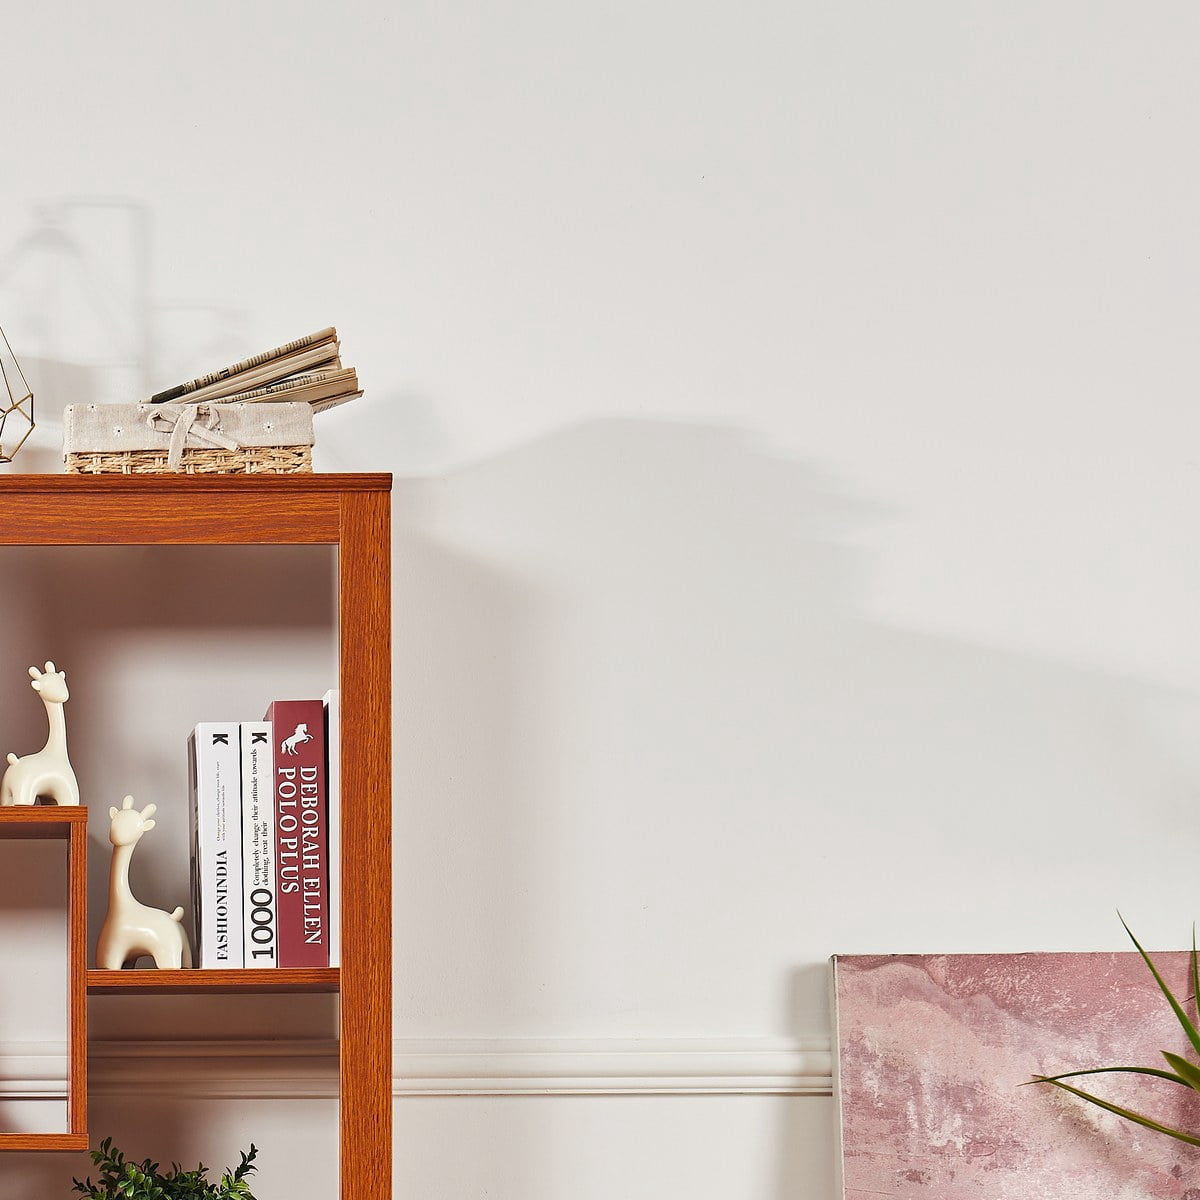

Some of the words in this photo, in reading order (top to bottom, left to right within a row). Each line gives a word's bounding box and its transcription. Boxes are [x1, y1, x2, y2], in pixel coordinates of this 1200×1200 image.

[212, 733, 229, 746] K
[250, 749, 258, 775] towards
[251, 732, 268, 745] K
[278, 767, 298, 832] POLO
[300, 766, 320, 870] DEBORAH
[253, 823, 261, 847] change
[253, 849, 261, 886] Completely
[280, 837, 299, 893] PLUS
[216, 850, 228, 960] FASHIONINDIA
[250, 888, 274, 959] 1000
[303, 877, 322, 945] ELLEN
